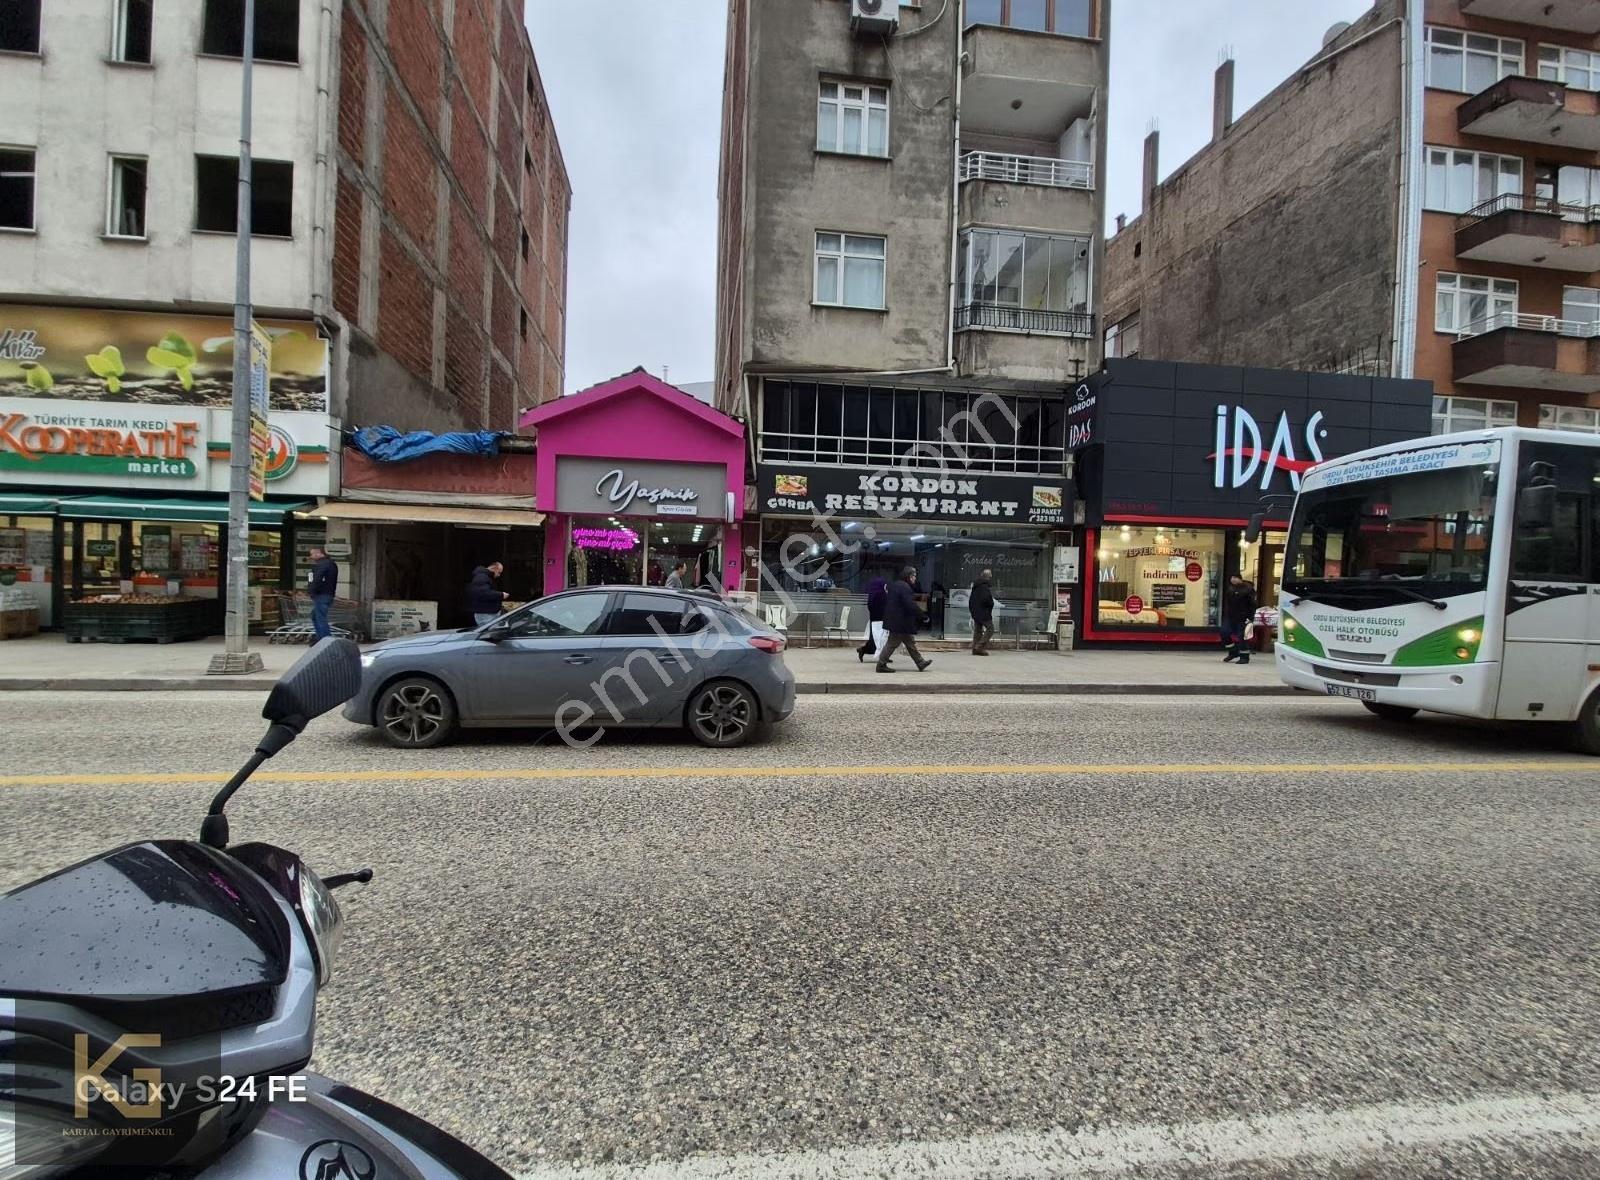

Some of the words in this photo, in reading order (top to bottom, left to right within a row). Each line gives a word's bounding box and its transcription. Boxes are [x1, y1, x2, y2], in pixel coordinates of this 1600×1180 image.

[1068, 395, 1096, 415] KORDON
[34, 413, 86, 427] TÜRKİYE
[90, 418, 128, 428] TARIM
[132, 419, 168, 430] KREDİ
[128, 460, 187, 475] market
[595, 469, 698, 512] Yasmin
[858, 475, 978, 495] KORDON
[825, 493, 1018, 516] RESTAURANT
[1143, 569, 1179, 579] indirim
[1366, 616, 1406, 627] BELEDİYESİ
[1336, 625, 1355, 634] HALK
[1358, 626, 1399, 637] OTOBÜSÜ
[1336, 634, 1372, 643] ISUZU
